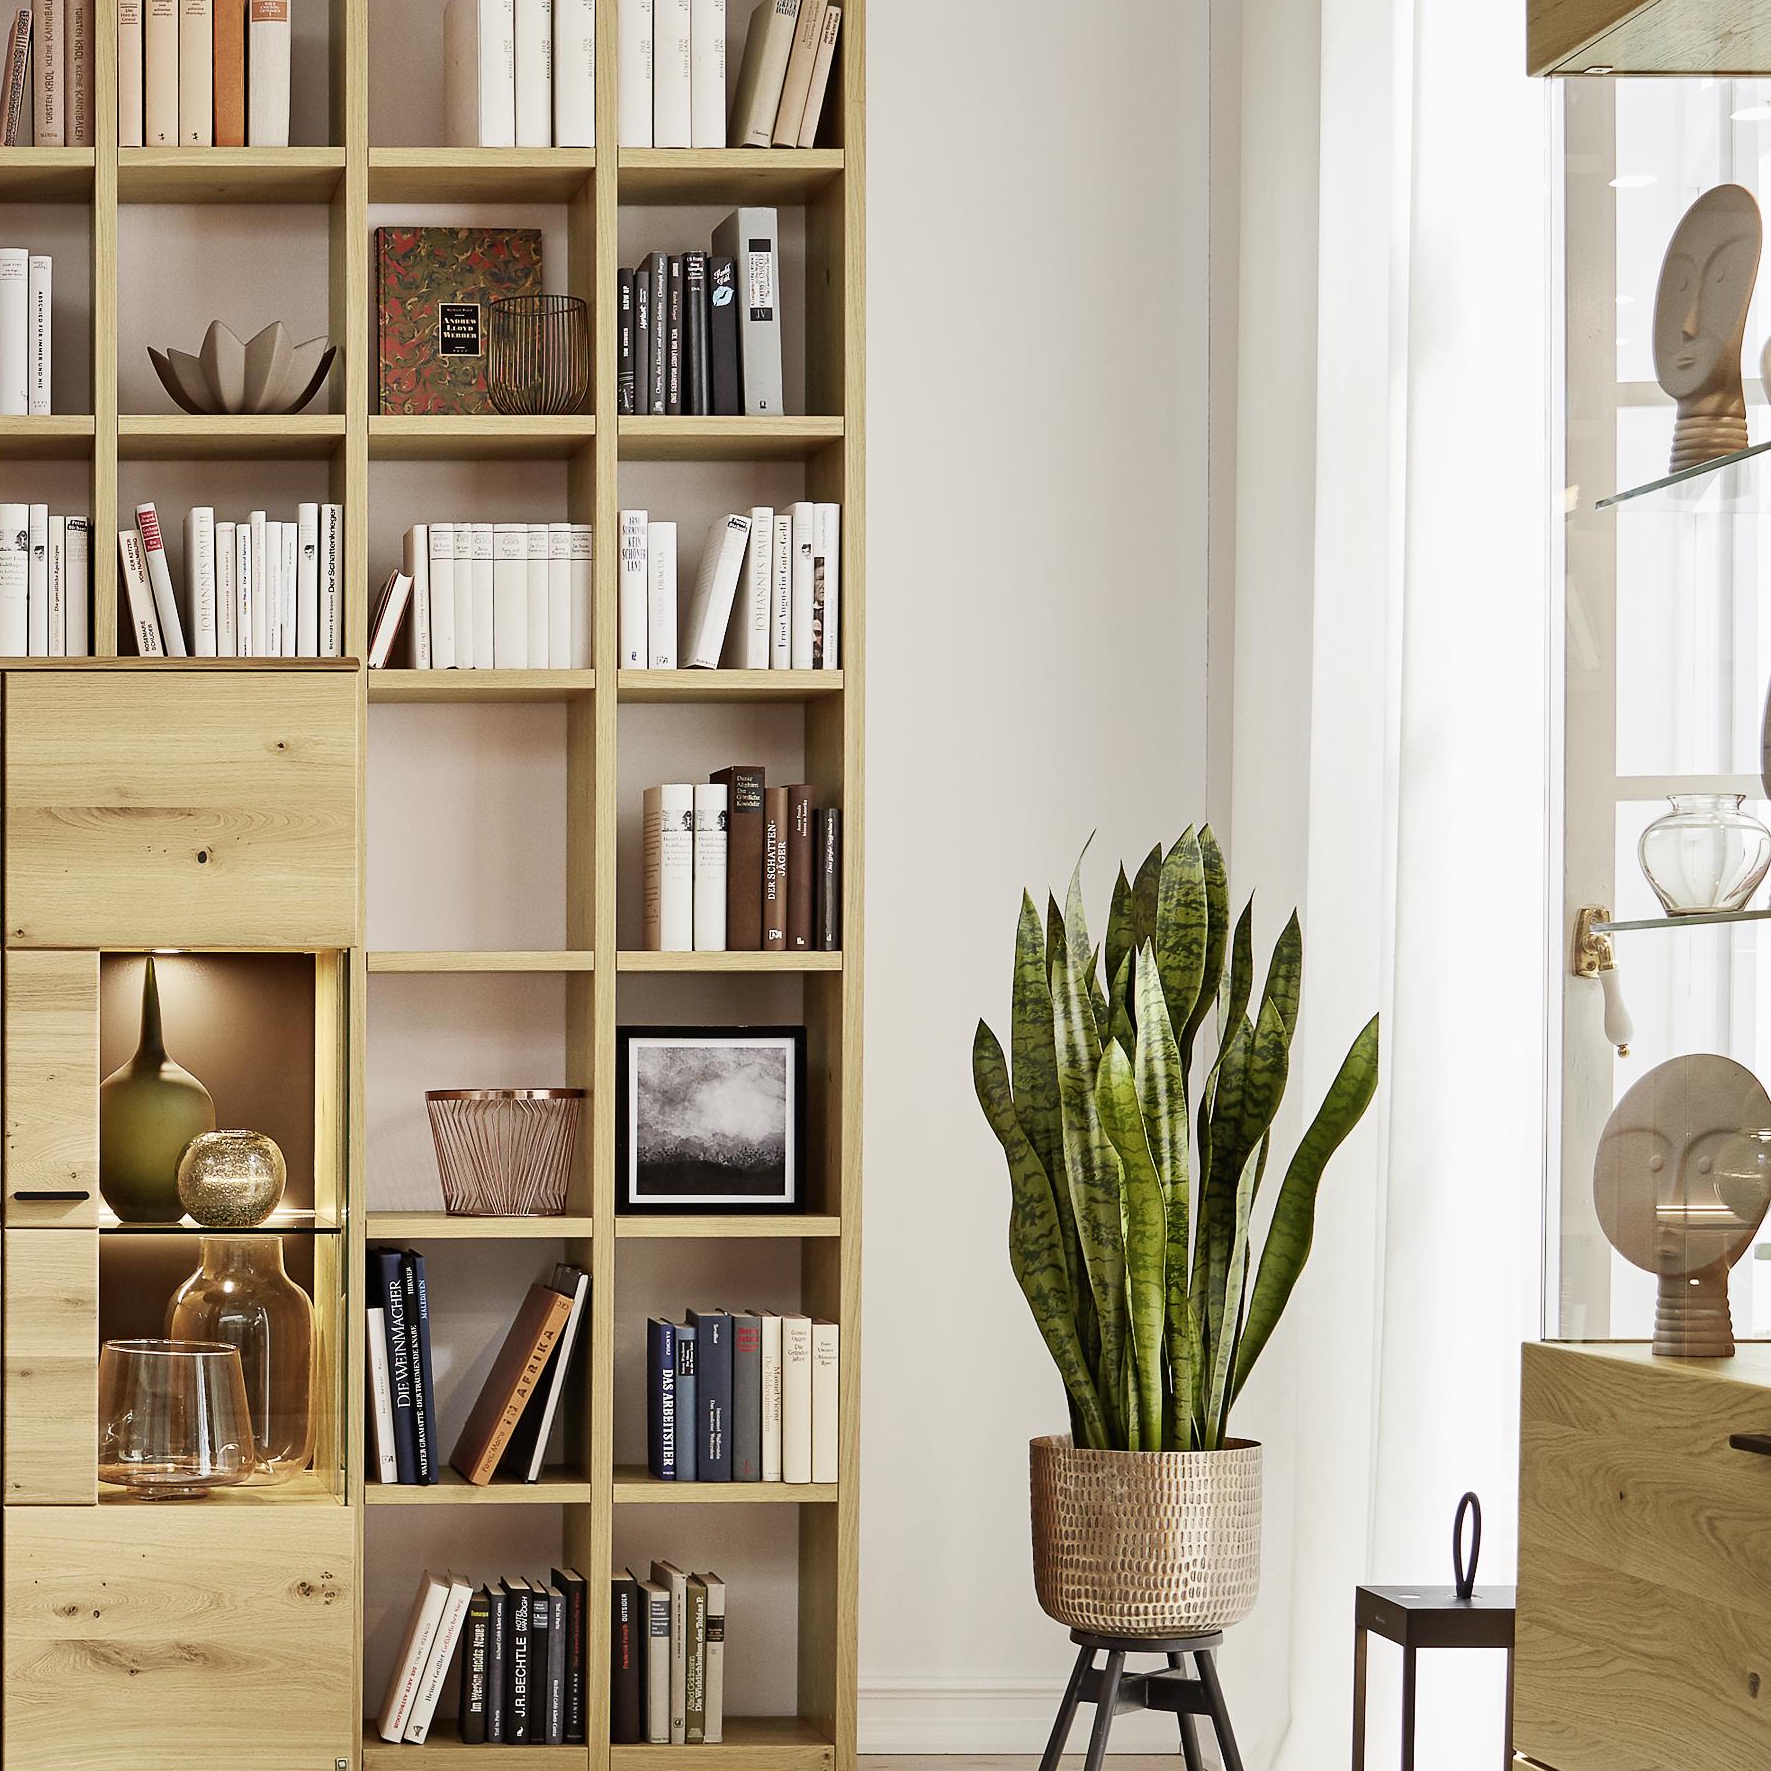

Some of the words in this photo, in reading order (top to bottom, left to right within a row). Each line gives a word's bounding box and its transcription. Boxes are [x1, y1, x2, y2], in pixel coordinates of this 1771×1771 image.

[75, 8, 84, 37] TORSTEN
[75, 39, 84, 61] KROL
[45, 71, 54, 92] KROL
[45, 94, 53, 125] TORSTEN
[75, 90, 84, 141] KANNIBALEN
[443, 331, 477, 339] WEBBER
[199, 530, 210, 558] PAUL
[328, 508, 337, 577] Schattenkrieger
[757, 529, 768, 558] PAUL
[779, 522, 788, 545] Geld
[779, 546, 788, 574] Gutes
[199, 562, 213, 632] JOHANNES
[755, 563, 766, 631] JOHANNES
[778, 576, 788, 619] Augustin
[777, 619, 787, 648] Ernst
[766, 819, 777, 881] SCHATTEN-
[777, 840, 787, 877] JÄGER
[767, 882, 776, 900] DER
[405, 1266, 414, 1295] HIRMER
[418, 1279, 428, 1320] MALEDIVEN
[388, 1279, 408, 1380] WEINMACHER
[409, 1324, 418, 1349] KNABE
[411, 1348, 422, 1394] TRÄUMENDE
[517, 1330, 555, 1399] AFRIKA
[764, 1356, 772, 1372] Die
[662, 1369, 674, 1392] DAS
[396, 1383, 412, 1408] DIE
[414, 1393, 424, 1408] DER
[662, 1392, 674, 1467] ARBEITSTIER
[419, 1448, 428, 1477] WALTER
[453, 1599, 464, 1613] Sieg
[696, 1603, 704, 1628] Tobias
[439, 1613, 459, 1653] Gefährlicher
[472, 1624, 486, 1648] Neues
[696, 1628, 704, 1642] des
[409, 1667, 418, 1677] DIE
[431, 1654, 446, 1679] Geißler
[471, 1649, 484, 1673] nichts
[515, 1637, 527, 1694] BECHTLE
[687, 1655, 696, 1691] Goldmann
[695, 1642, 704, 1698] Wirklichkeiten
[404, 1677, 415, 1693] AKTE
[425, 1679, 439, 1702] Heiner
[393, 1693, 410, 1730] ASTROLOGIE
[470, 1702, 483, 1712] Im
[516, 1694, 527, 1718] J.R.
